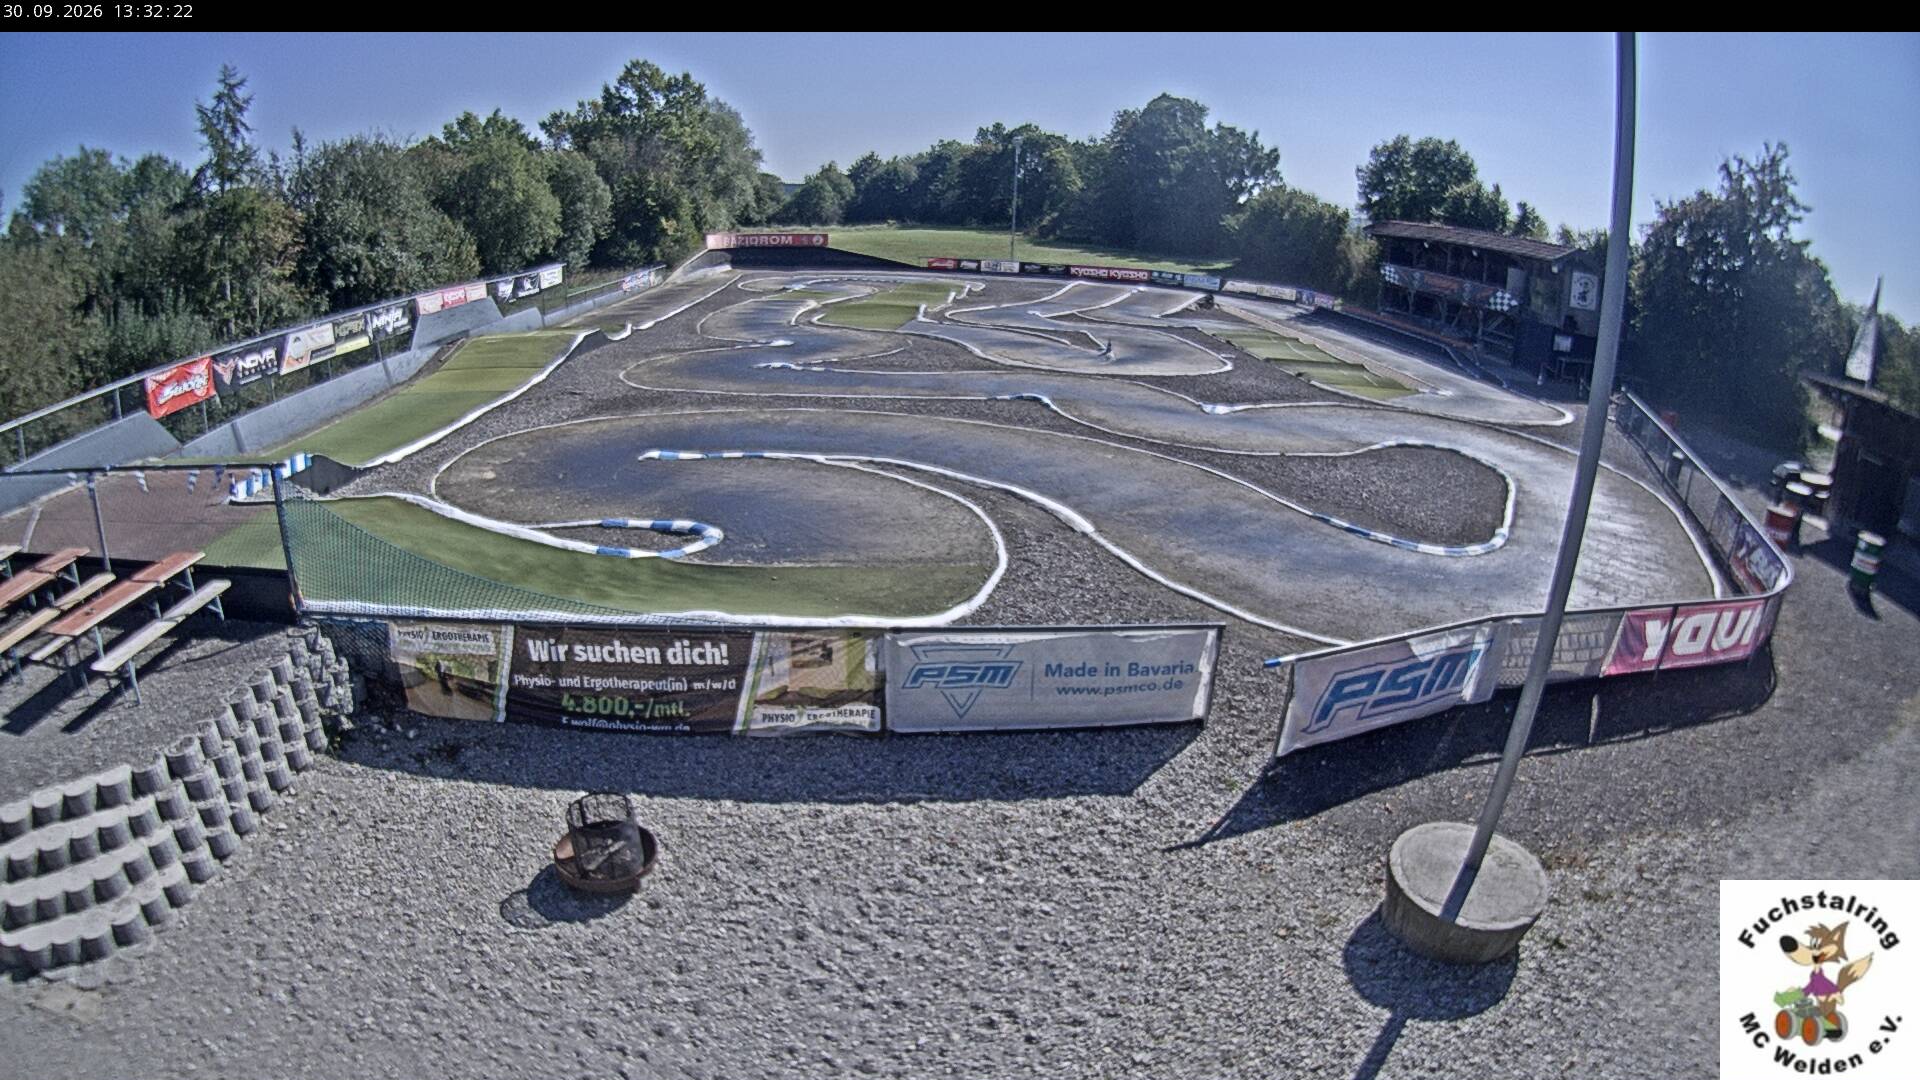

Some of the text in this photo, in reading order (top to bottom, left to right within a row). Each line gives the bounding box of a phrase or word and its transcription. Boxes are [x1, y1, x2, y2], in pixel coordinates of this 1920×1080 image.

[238, 347, 277, 372] NOVA
[527, 638, 730, 666] Wir suchen dich!
[907, 663, 1017, 687] PSM
[1044, 660, 1194, 678] Made in Bavaria
[513, 674, 556, 688] Physio-
[558, 675, 580, 688] und
[583, 676, 688, 692] Ergotherapeut(in)
[1056, 677, 1184, 696] www.psmco.de
[762, 712, 795, 723] PHYSIO
